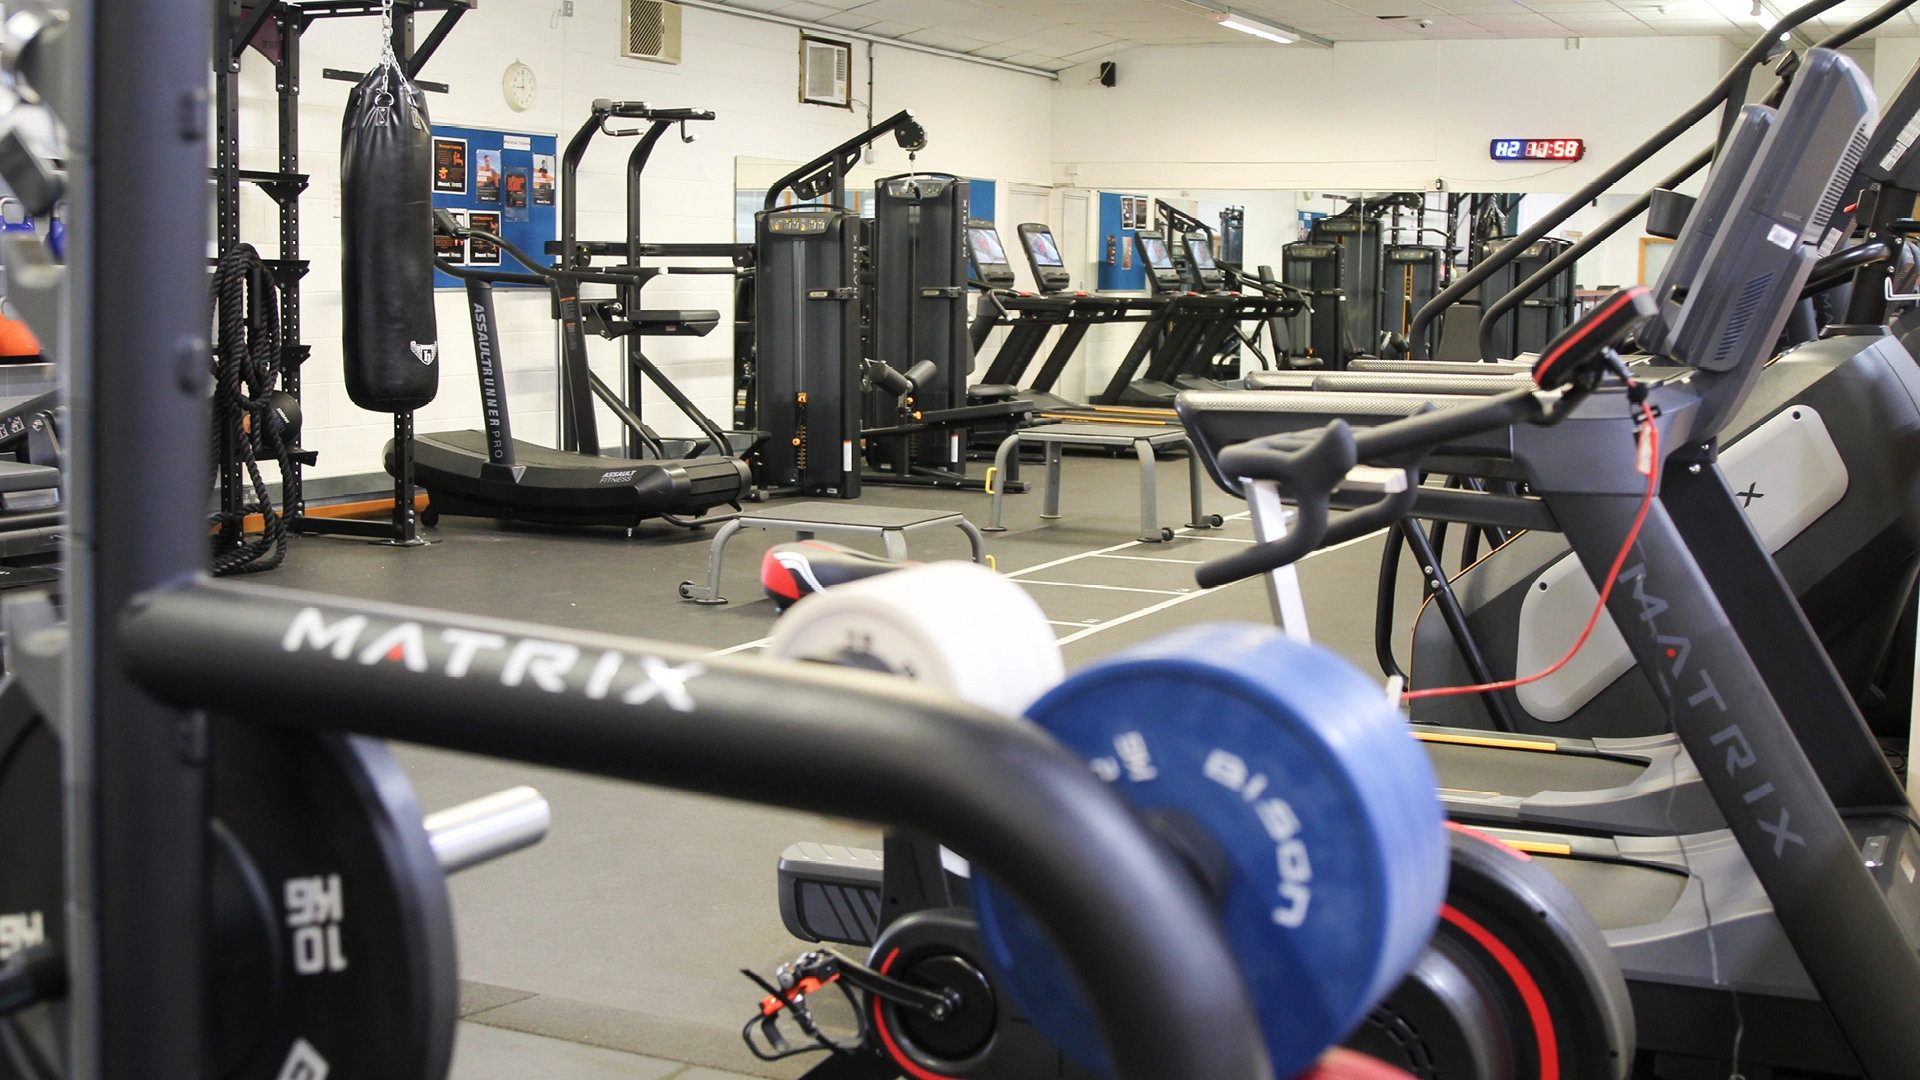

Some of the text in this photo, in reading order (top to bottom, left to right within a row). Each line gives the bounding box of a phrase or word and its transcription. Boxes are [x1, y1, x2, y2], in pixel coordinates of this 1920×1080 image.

[1529, 141, 1579, 157] 11:58
[492, 430, 503, 459] PRO
[602, 470, 637, 478] ASSAULT
[281, 606, 704, 713] MATRIX
[1617, 563, 1806, 860] MATRIX
[284, 872, 344, 927] KG
[293, 924, 348, 976] 10
